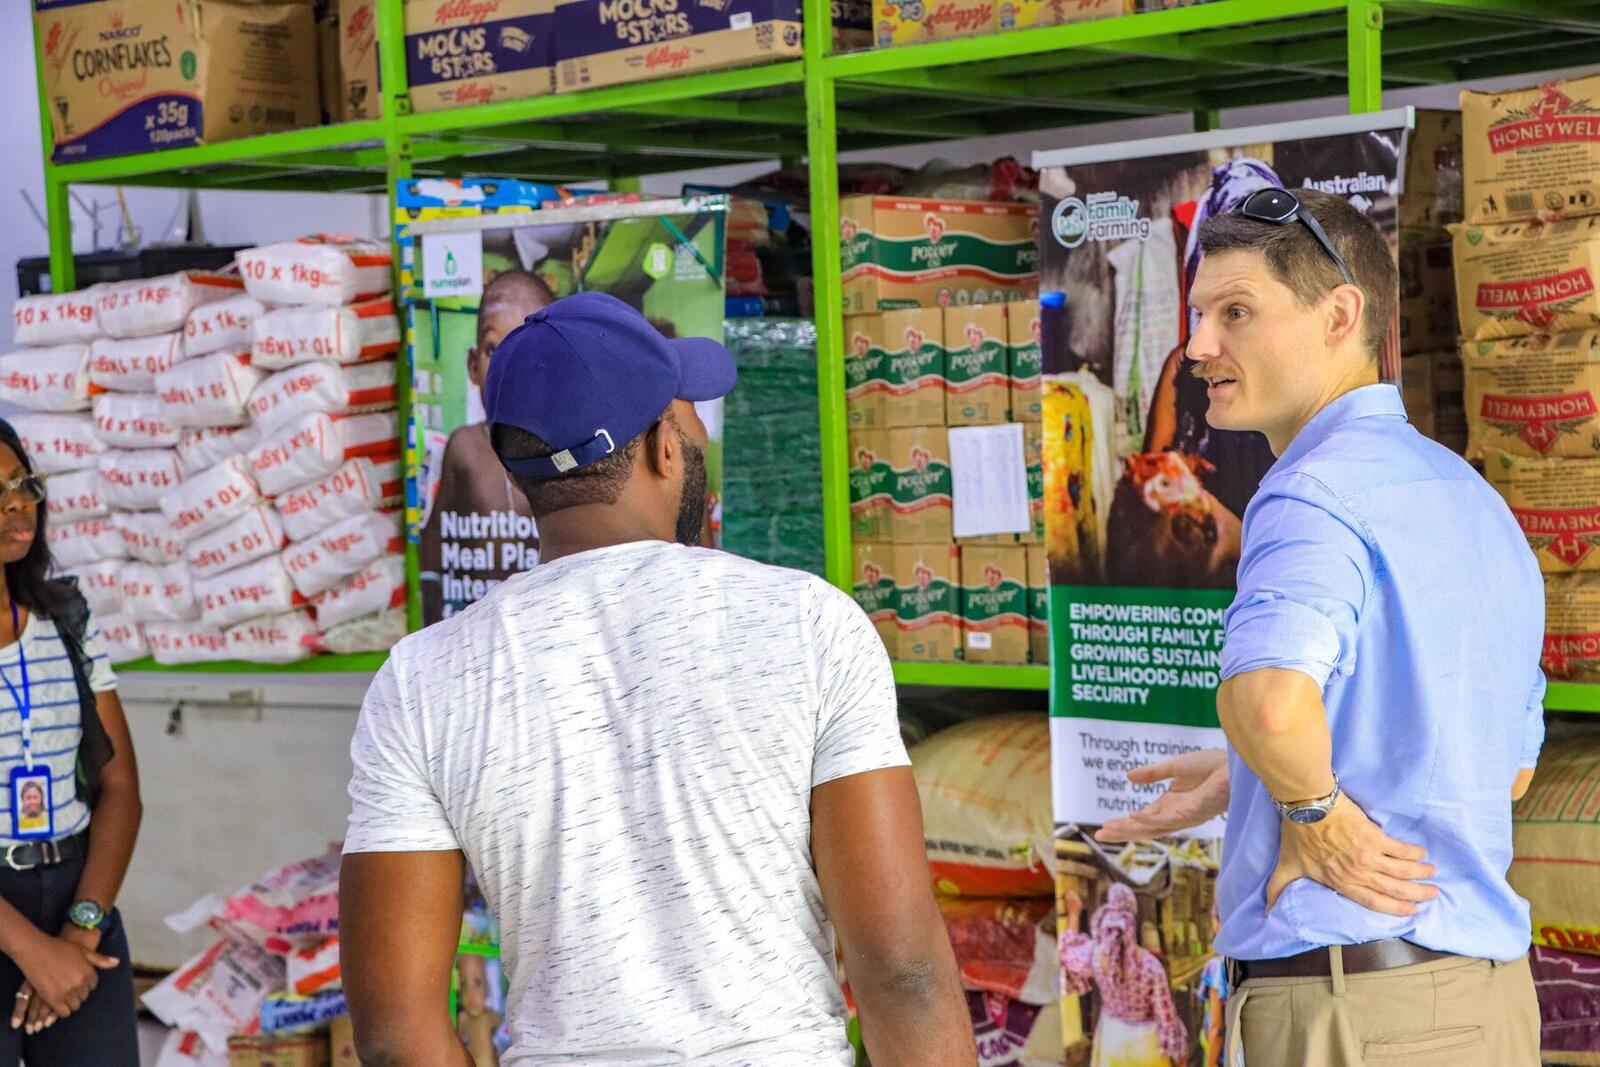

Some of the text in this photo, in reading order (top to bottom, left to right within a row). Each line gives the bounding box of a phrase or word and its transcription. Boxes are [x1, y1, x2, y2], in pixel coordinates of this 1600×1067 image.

[73, 36, 172, 81] CORNFLAKES
[157, 101, 189, 126] 35g
[1302, 171, 1386, 194] Australian
[1088, 202, 1136, 220] Family
[1088, 220, 1150, 239] Farming
[245, 260, 321, 288] 10 x 1kg
[1480, 274, 1586, 303] HONEYWELL
[15, 303, 94, 325] 10 x 1kg
[185, 320, 197, 337] 0
[1486, 397, 1590, 418] HONEYWELL
[21, 437, 30, 452] 0
[441, 541, 540, 571] Meal Pla
[1069, 602, 1226, 626] EMPOWERING COM
[1069, 623, 1225, 648] THROUGH FAMILY F
[1070, 643, 1223, 668] GROWING SUSTAIN
[1071, 664, 1219, 689] LIVELIHOODS AND
[1072, 683, 1150, 705] SECURITY
[1078, 732, 1140, 758] Through
[1082, 756, 1152, 772] we enabl
[1096, 775, 1128, 792] their
